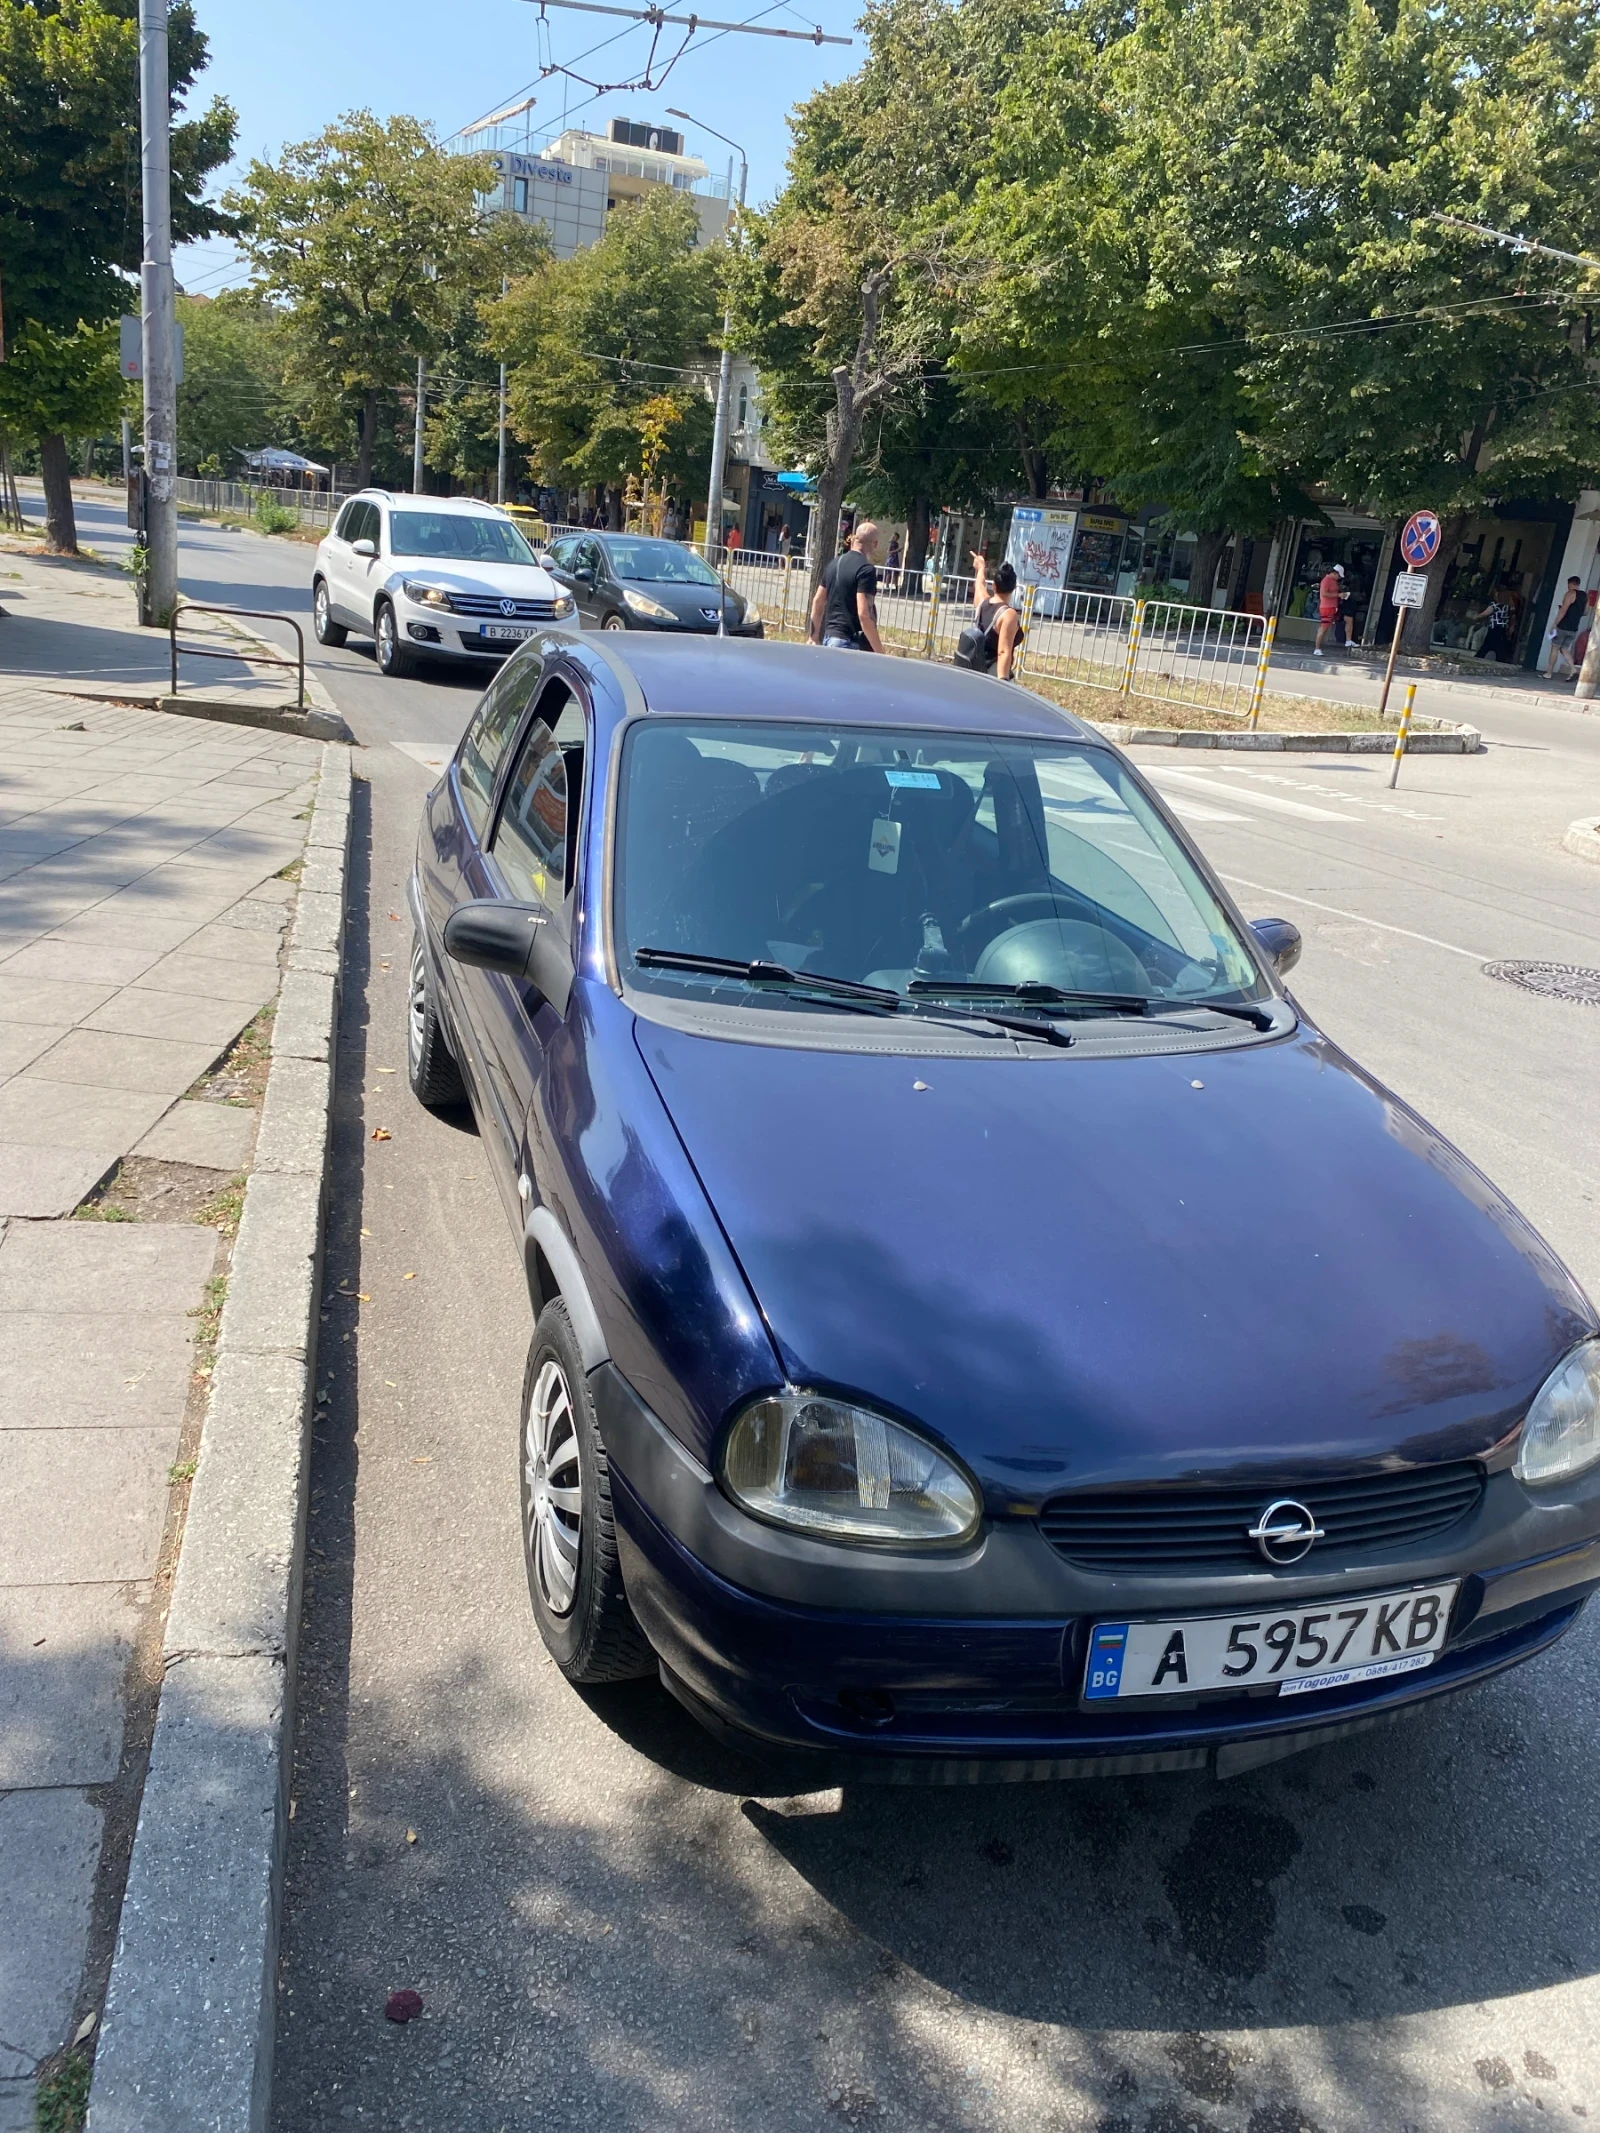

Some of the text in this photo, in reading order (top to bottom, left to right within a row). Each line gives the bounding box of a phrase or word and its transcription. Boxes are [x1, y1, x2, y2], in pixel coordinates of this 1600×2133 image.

[511, 156, 573, 184] Divesta
[501, 628, 522, 638] 2236
[1092, 1595, 1442, 1688] BG A 5957 KB
[1365, 1662, 1408, 1677] 0888/417
[1410, 1656, 1426, 1668] 282
